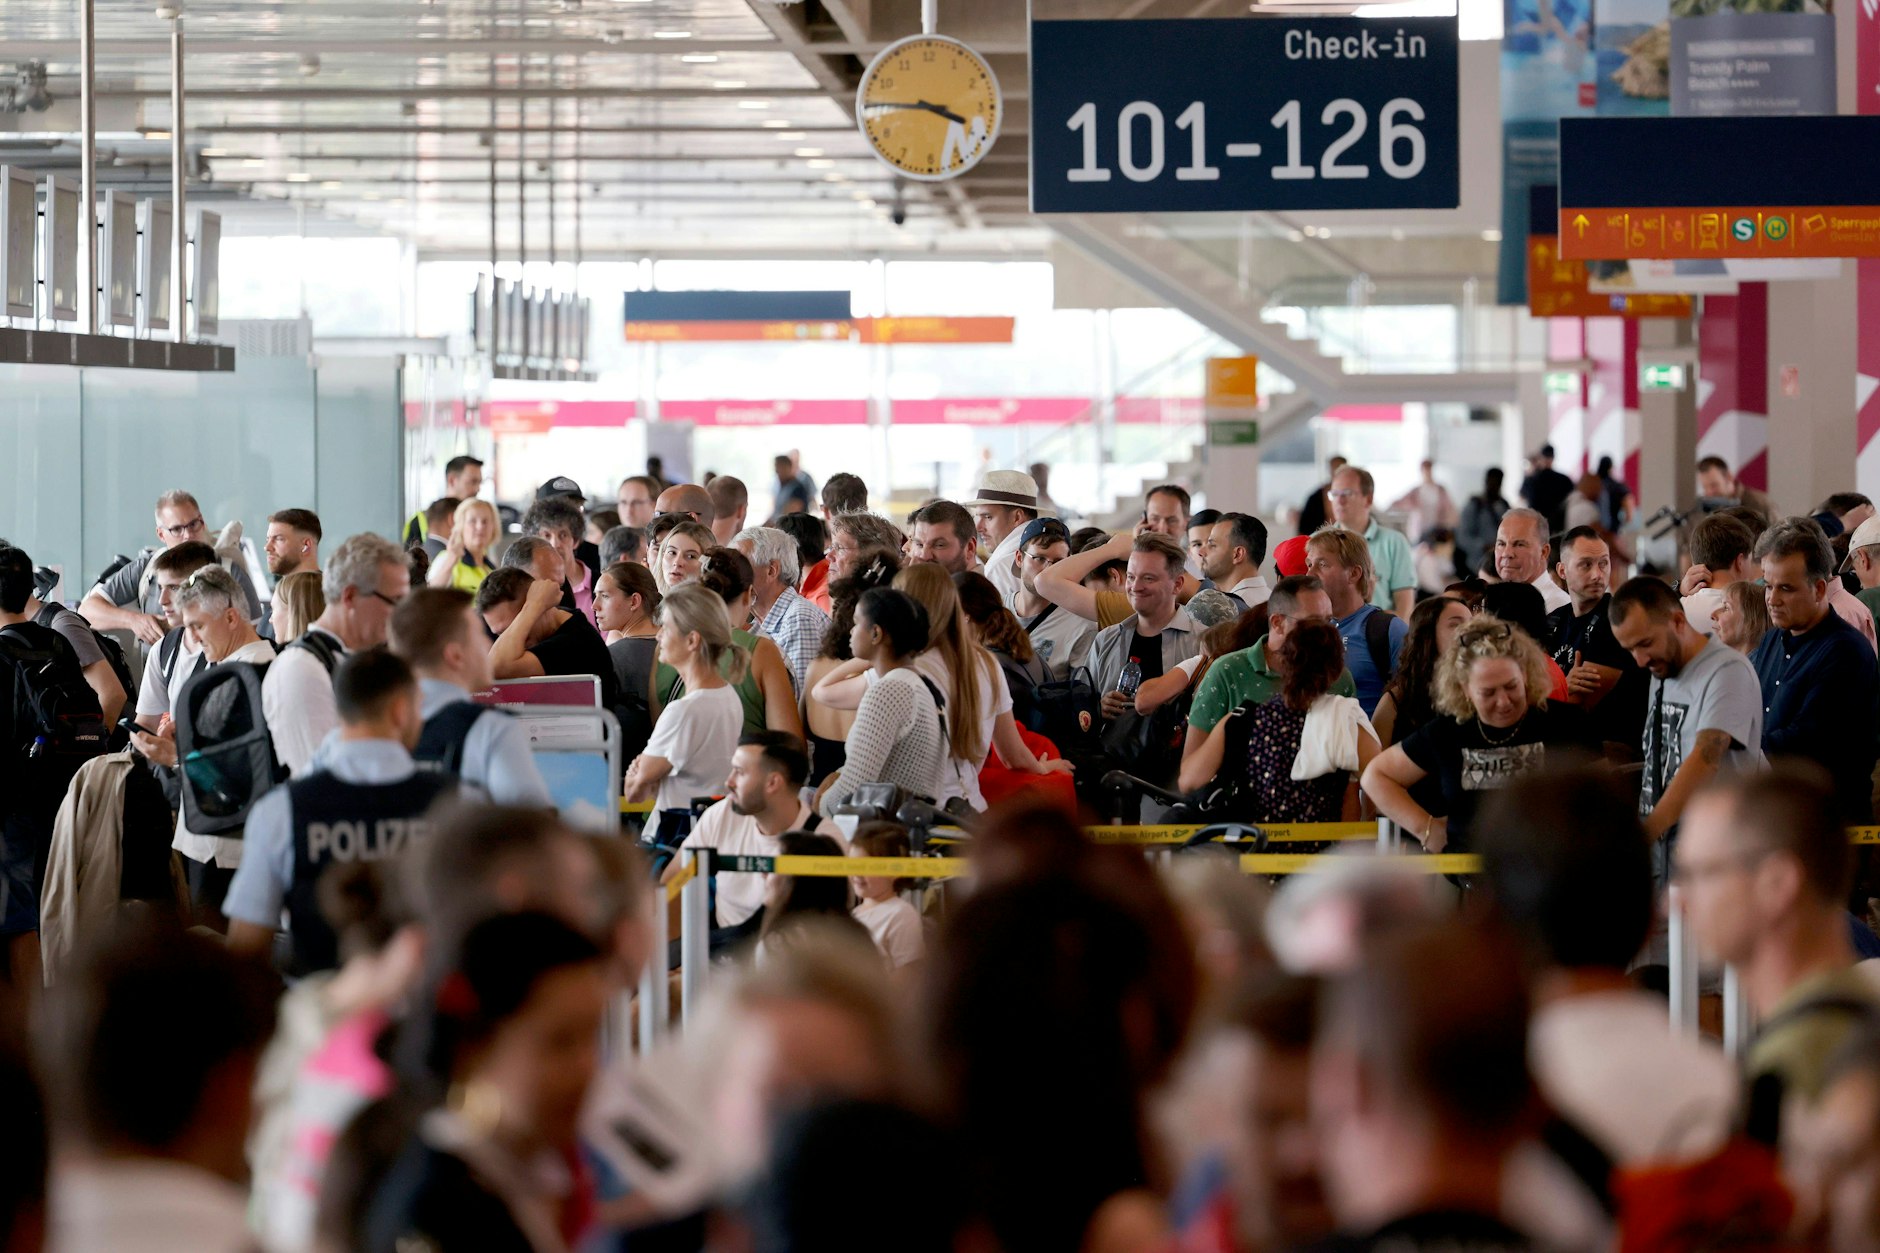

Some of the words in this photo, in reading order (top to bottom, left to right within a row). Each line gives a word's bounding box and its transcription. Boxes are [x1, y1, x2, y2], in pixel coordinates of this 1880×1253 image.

[1284, 28, 1427, 59] Check-in
[922, 51, 936, 62] 12
[899, 60, 910, 71] 11
[880, 78, 893, 89] 10
[969, 78, 977, 89] 2
[1066, 97, 1427, 182] 101-126
[1606, 215, 1623, 227] WC
[1830, 217, 1880, 231] Sperrgep
[1735, 219, 1755, 239] S
[307, 817, 435, 863] POLIZE
[1139, 830, 1168, 840] Airport
